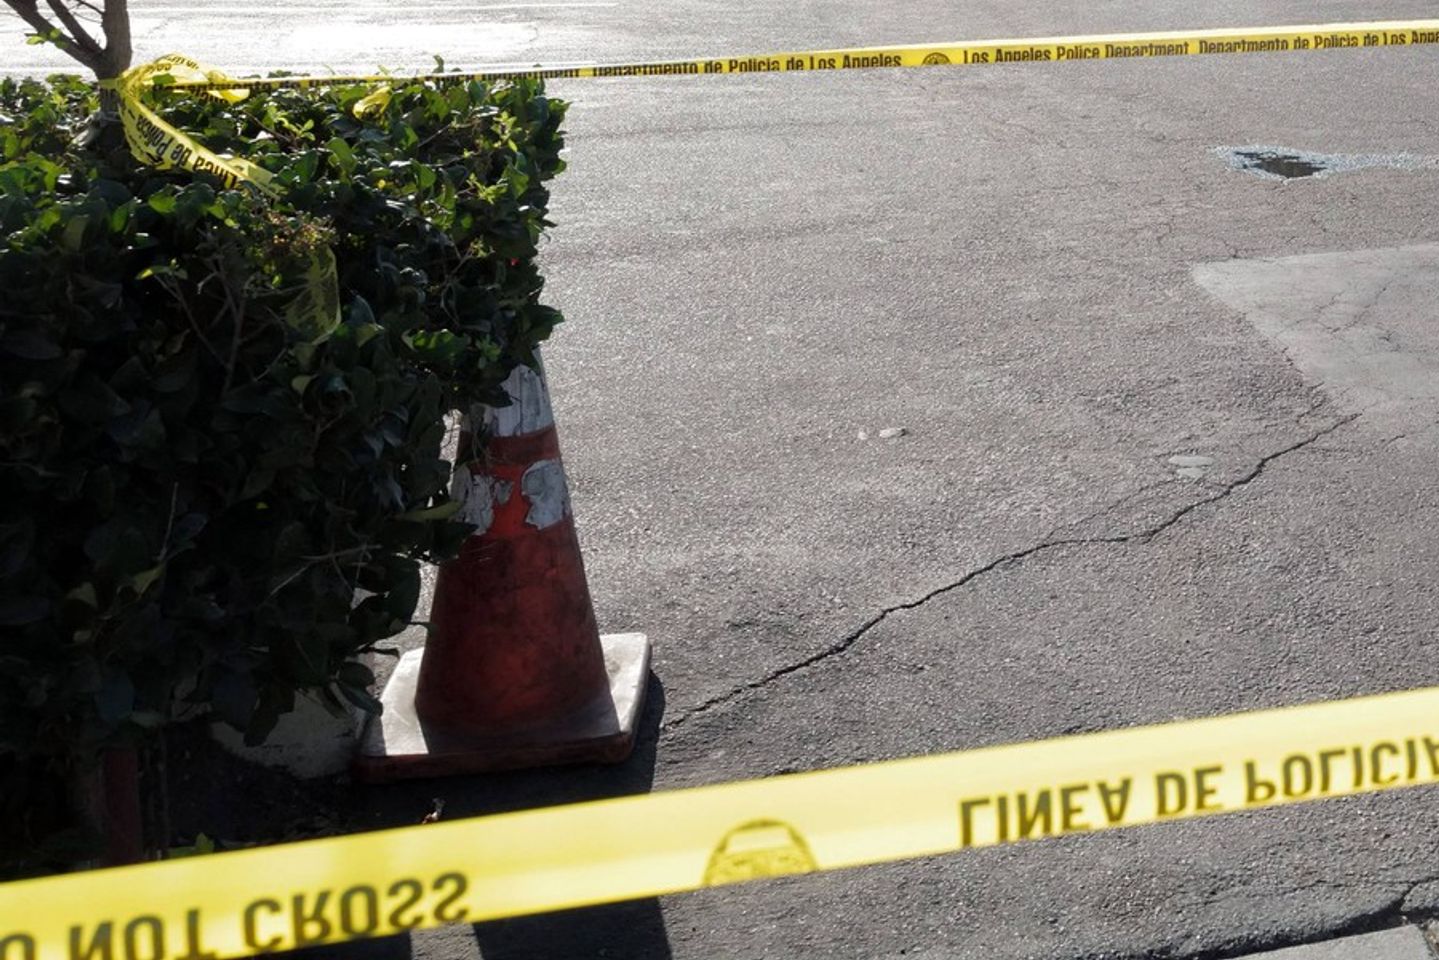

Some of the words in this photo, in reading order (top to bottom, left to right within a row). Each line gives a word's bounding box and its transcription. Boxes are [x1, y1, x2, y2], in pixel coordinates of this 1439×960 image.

[1056, 44, 1100, 61] Police
[729, 57, 780, 74] Policia
[786, 56, 804, 72] de
